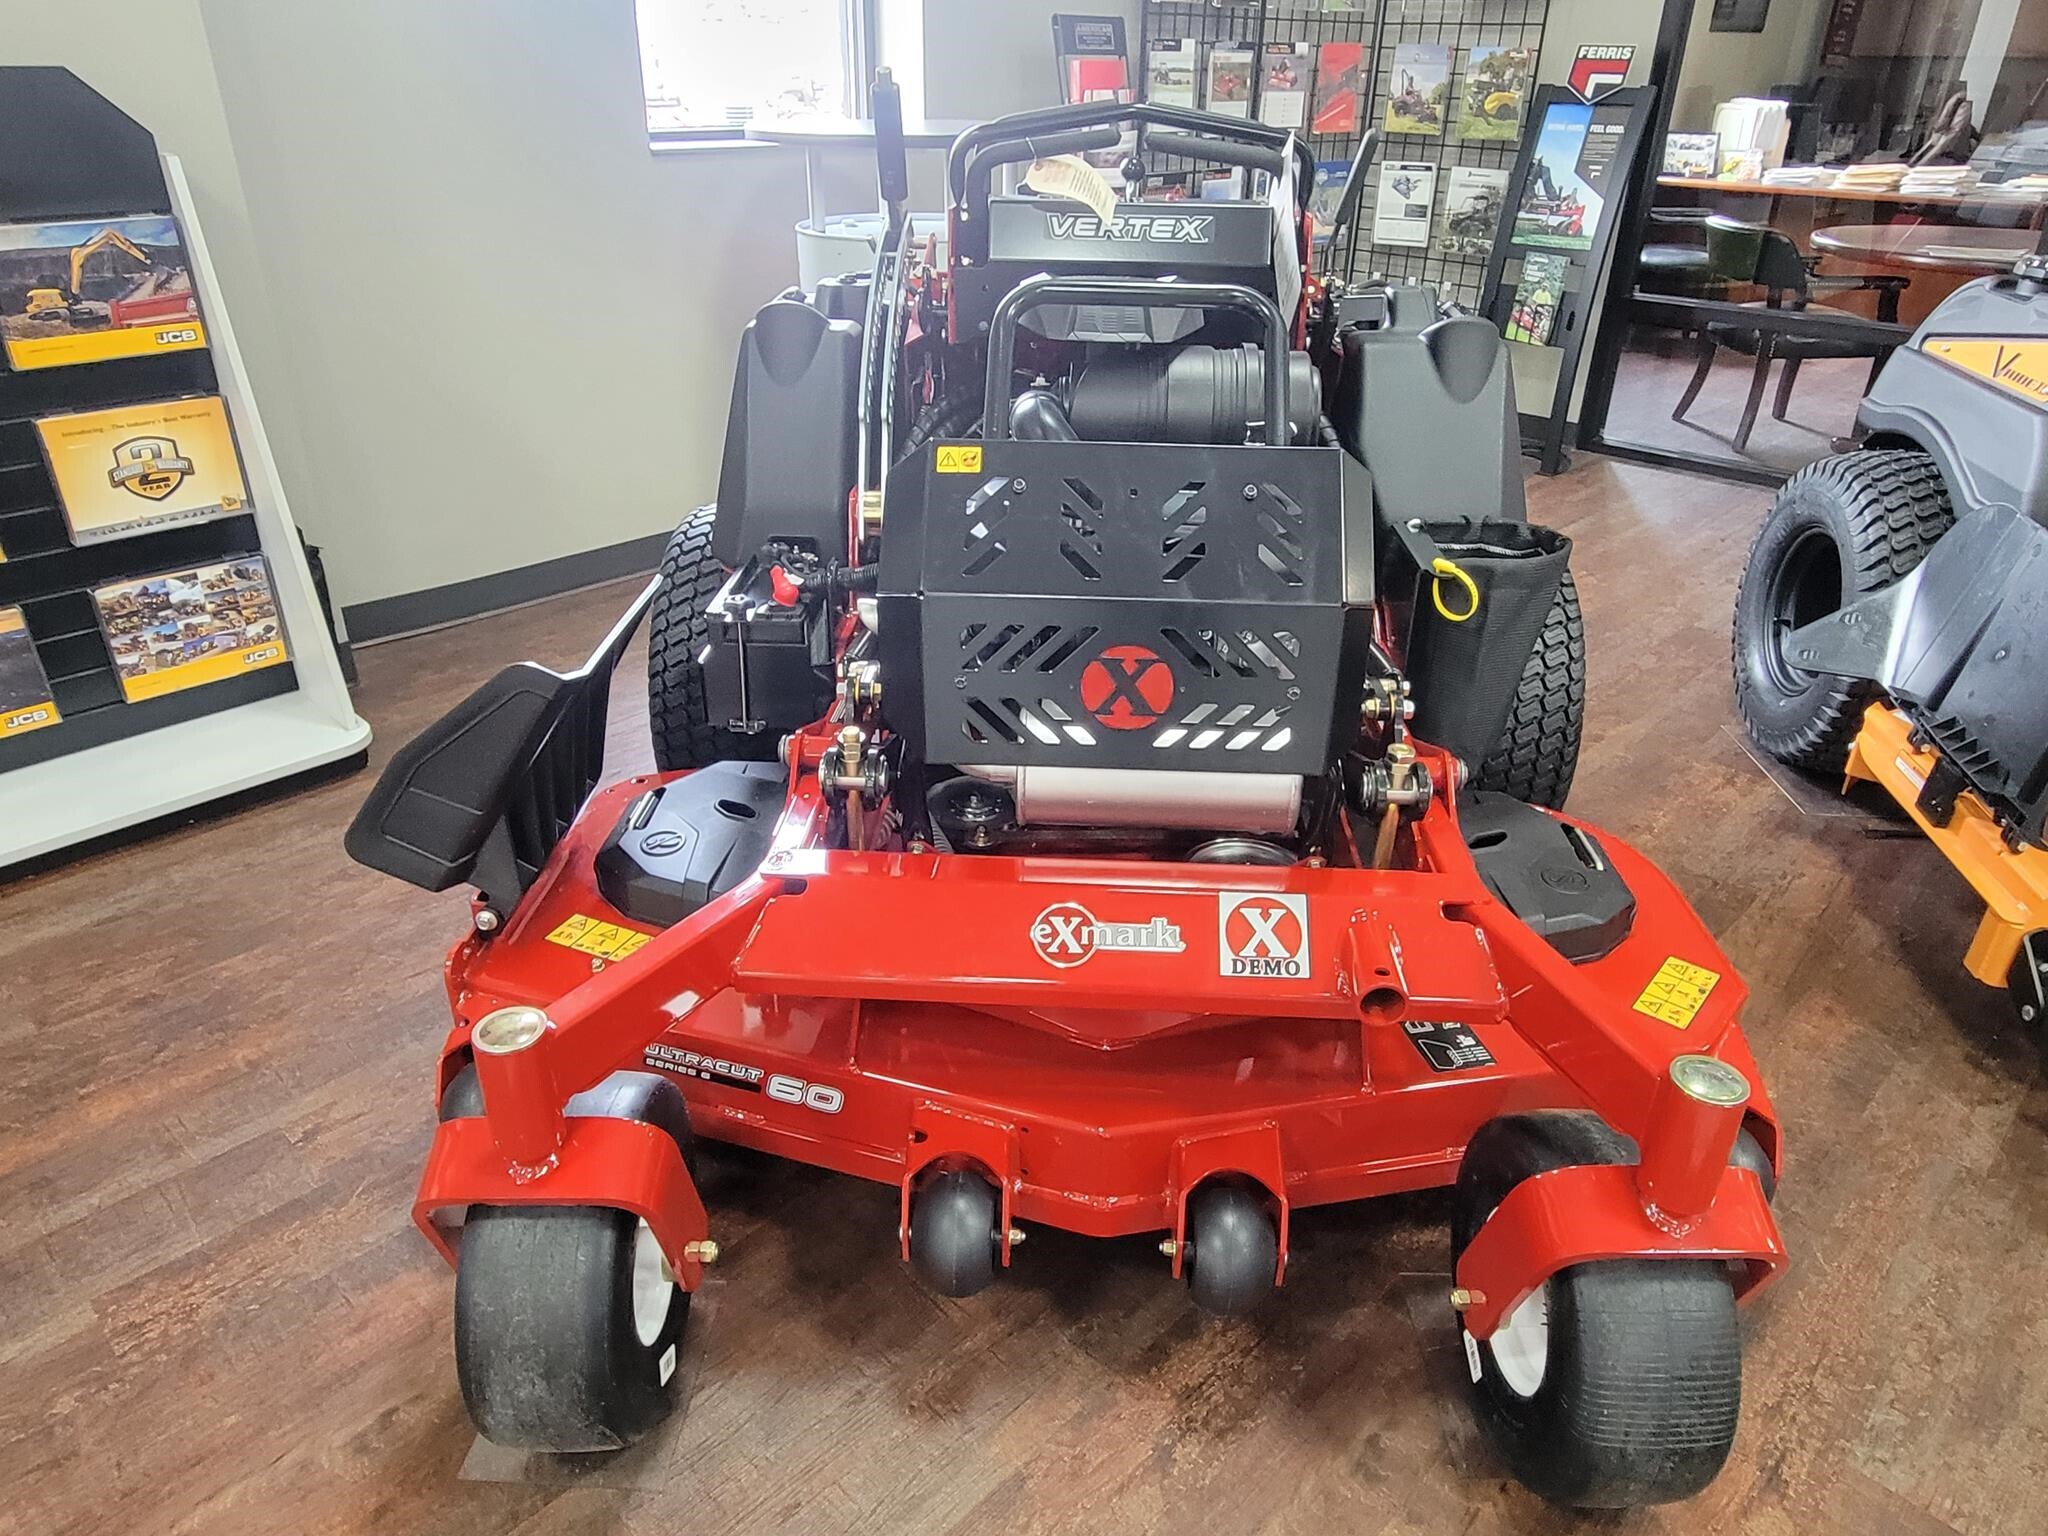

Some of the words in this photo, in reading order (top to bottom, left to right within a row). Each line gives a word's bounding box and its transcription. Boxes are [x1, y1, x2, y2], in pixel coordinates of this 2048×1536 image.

[1578, 46, 1632, 60] FERRIS
[1048, 214, 1212, 242] VERTEX
[156, 331, 198, 344] JCB
[244, 650, 279, 663] JCB
[6, 710, 49, 728] JCB
[1231, 958, 1301, 976] DEMO
[645, 1044, 763, 1081] ULTRACUT
[767, 1075, 844, 1113] 60
